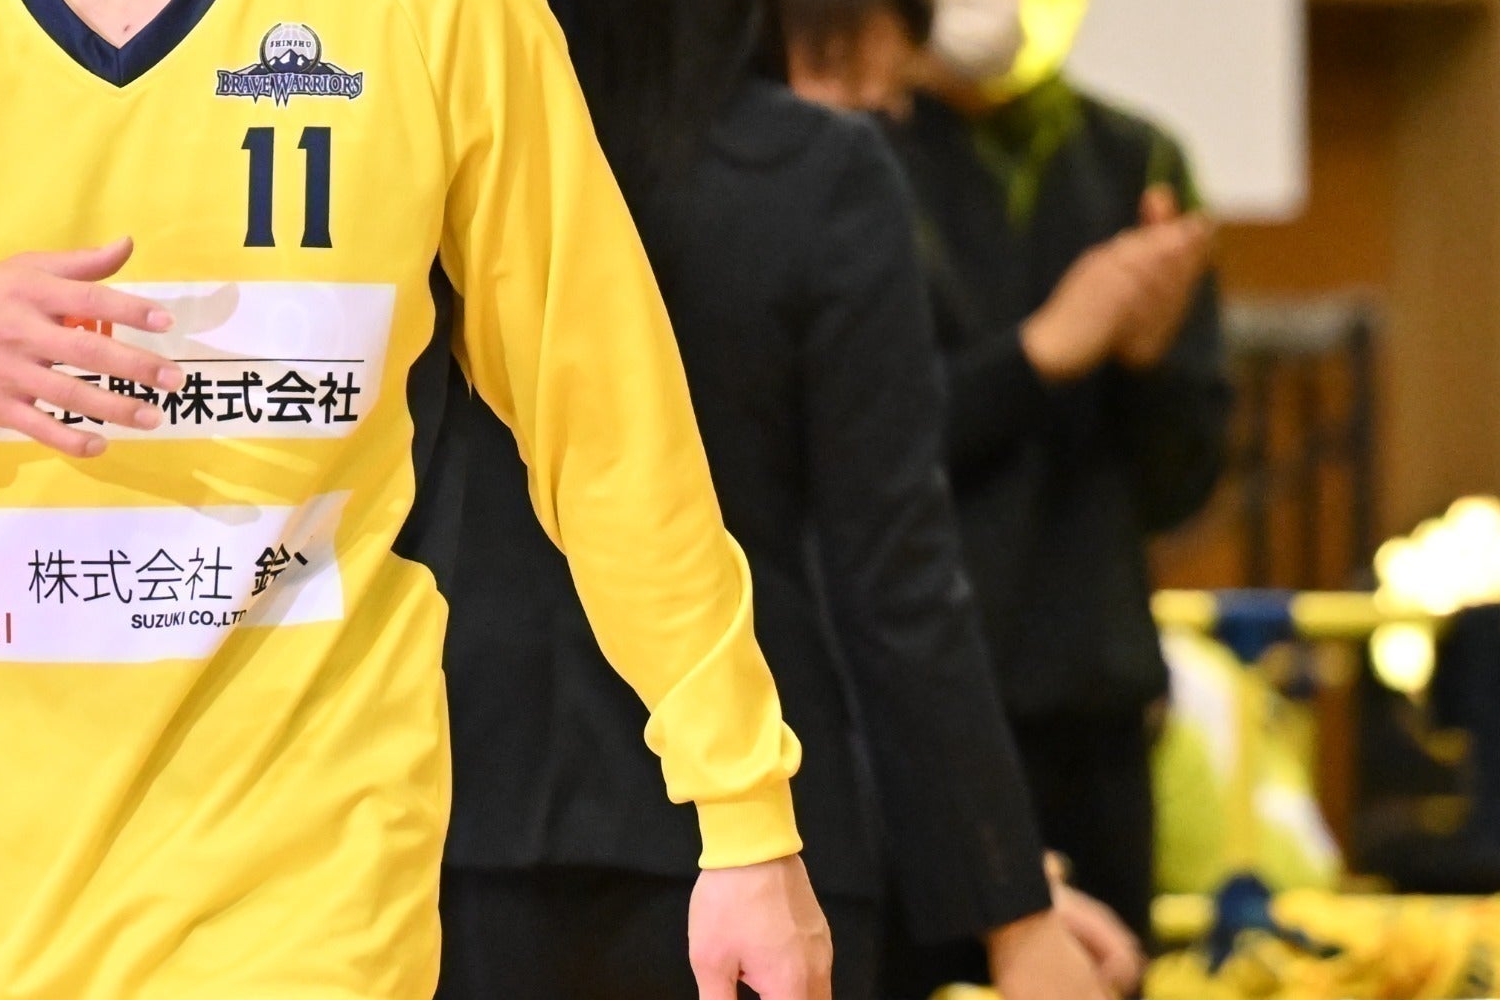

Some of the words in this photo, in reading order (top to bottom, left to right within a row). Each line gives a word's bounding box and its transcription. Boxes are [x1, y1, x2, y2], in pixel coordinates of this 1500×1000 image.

[270, 39, 312, 48] SHINSHU
[241, 126, 333, 248] 11
[28, 546, 232, 604] 株式会社
[251, 543, 308, 597] 鈴
[131, 611, 185, 629] SUZUKI
